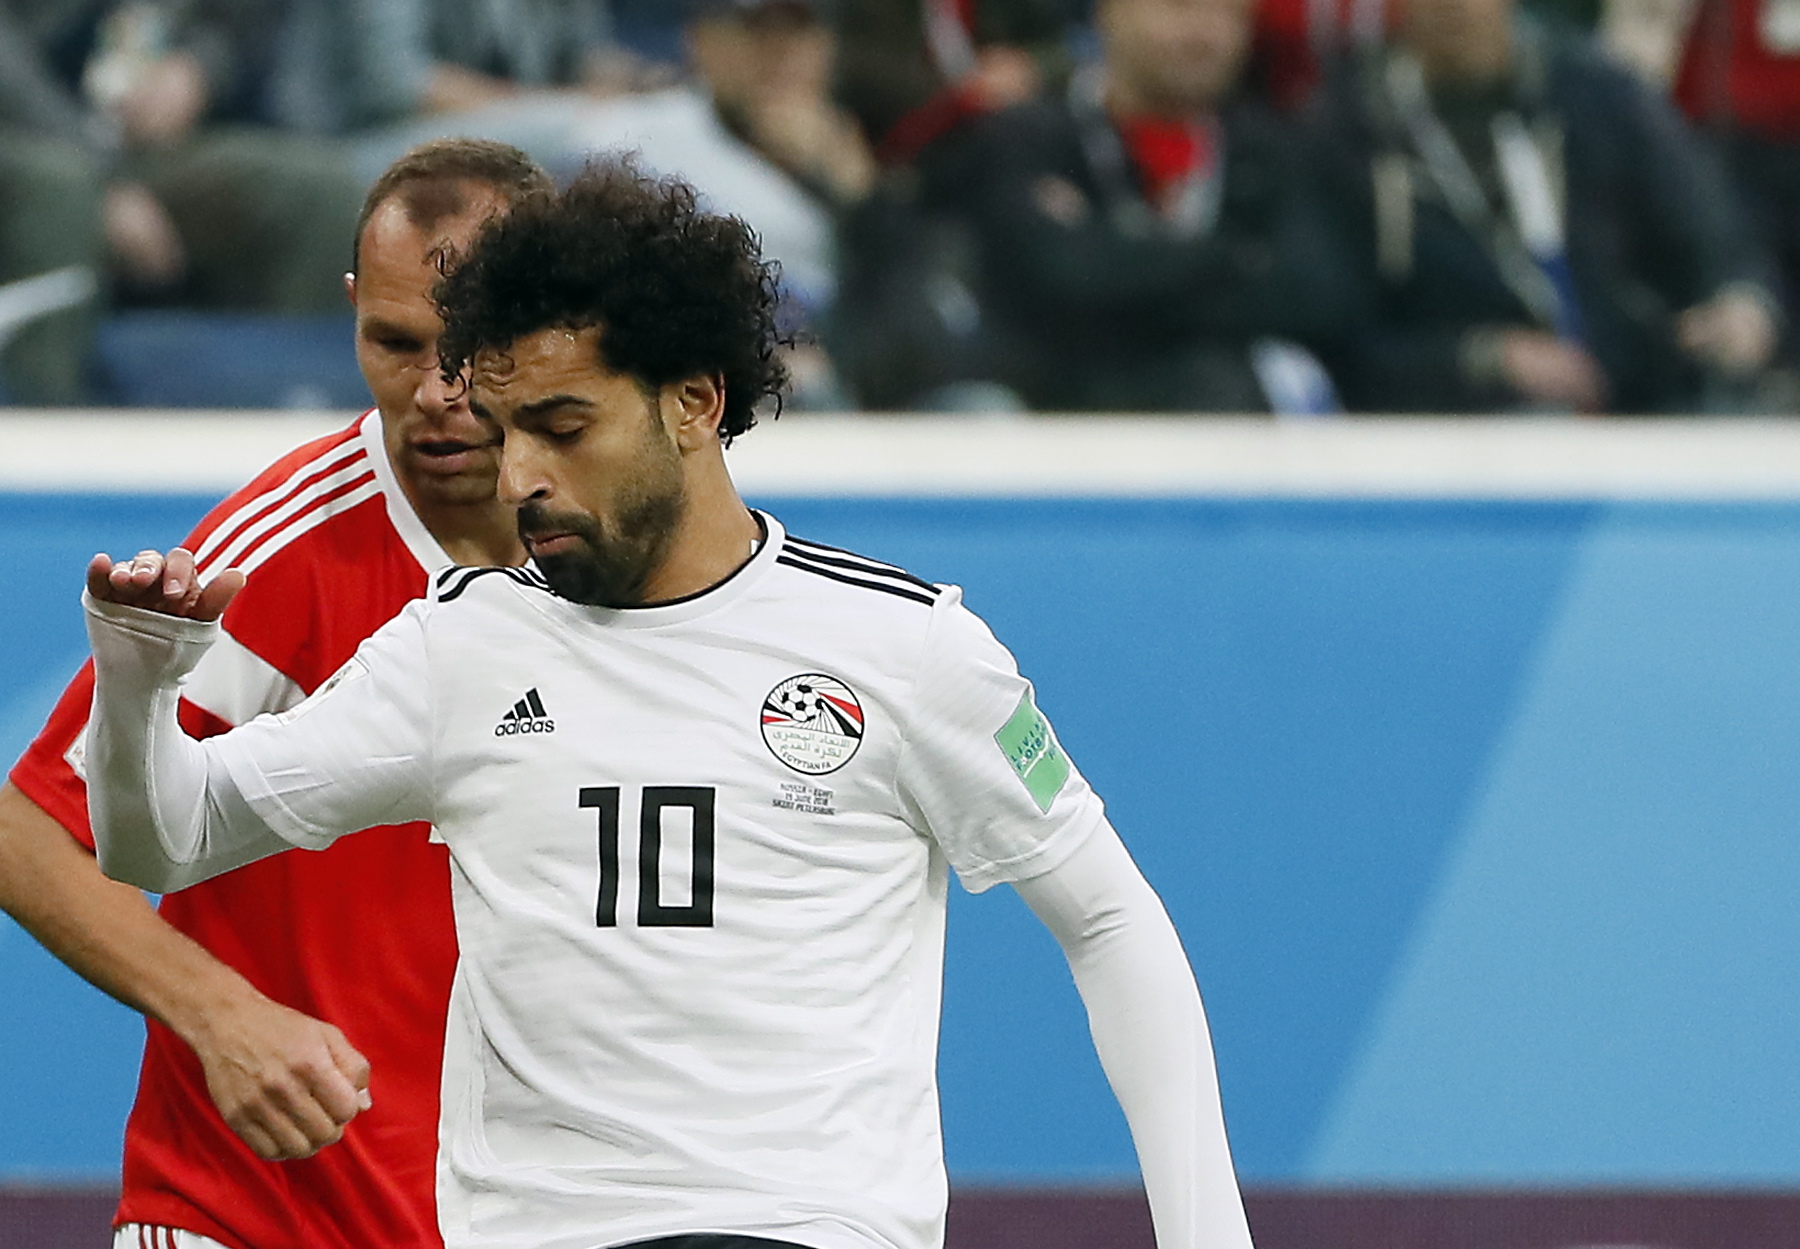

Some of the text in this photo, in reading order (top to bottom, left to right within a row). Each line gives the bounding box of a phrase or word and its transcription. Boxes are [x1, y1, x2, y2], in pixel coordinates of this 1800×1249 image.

[495, 718, 555, 737] adidas
[782, 752, 832, 770] EGYPTIAN FA
[578, 786, 716, 928] 10
